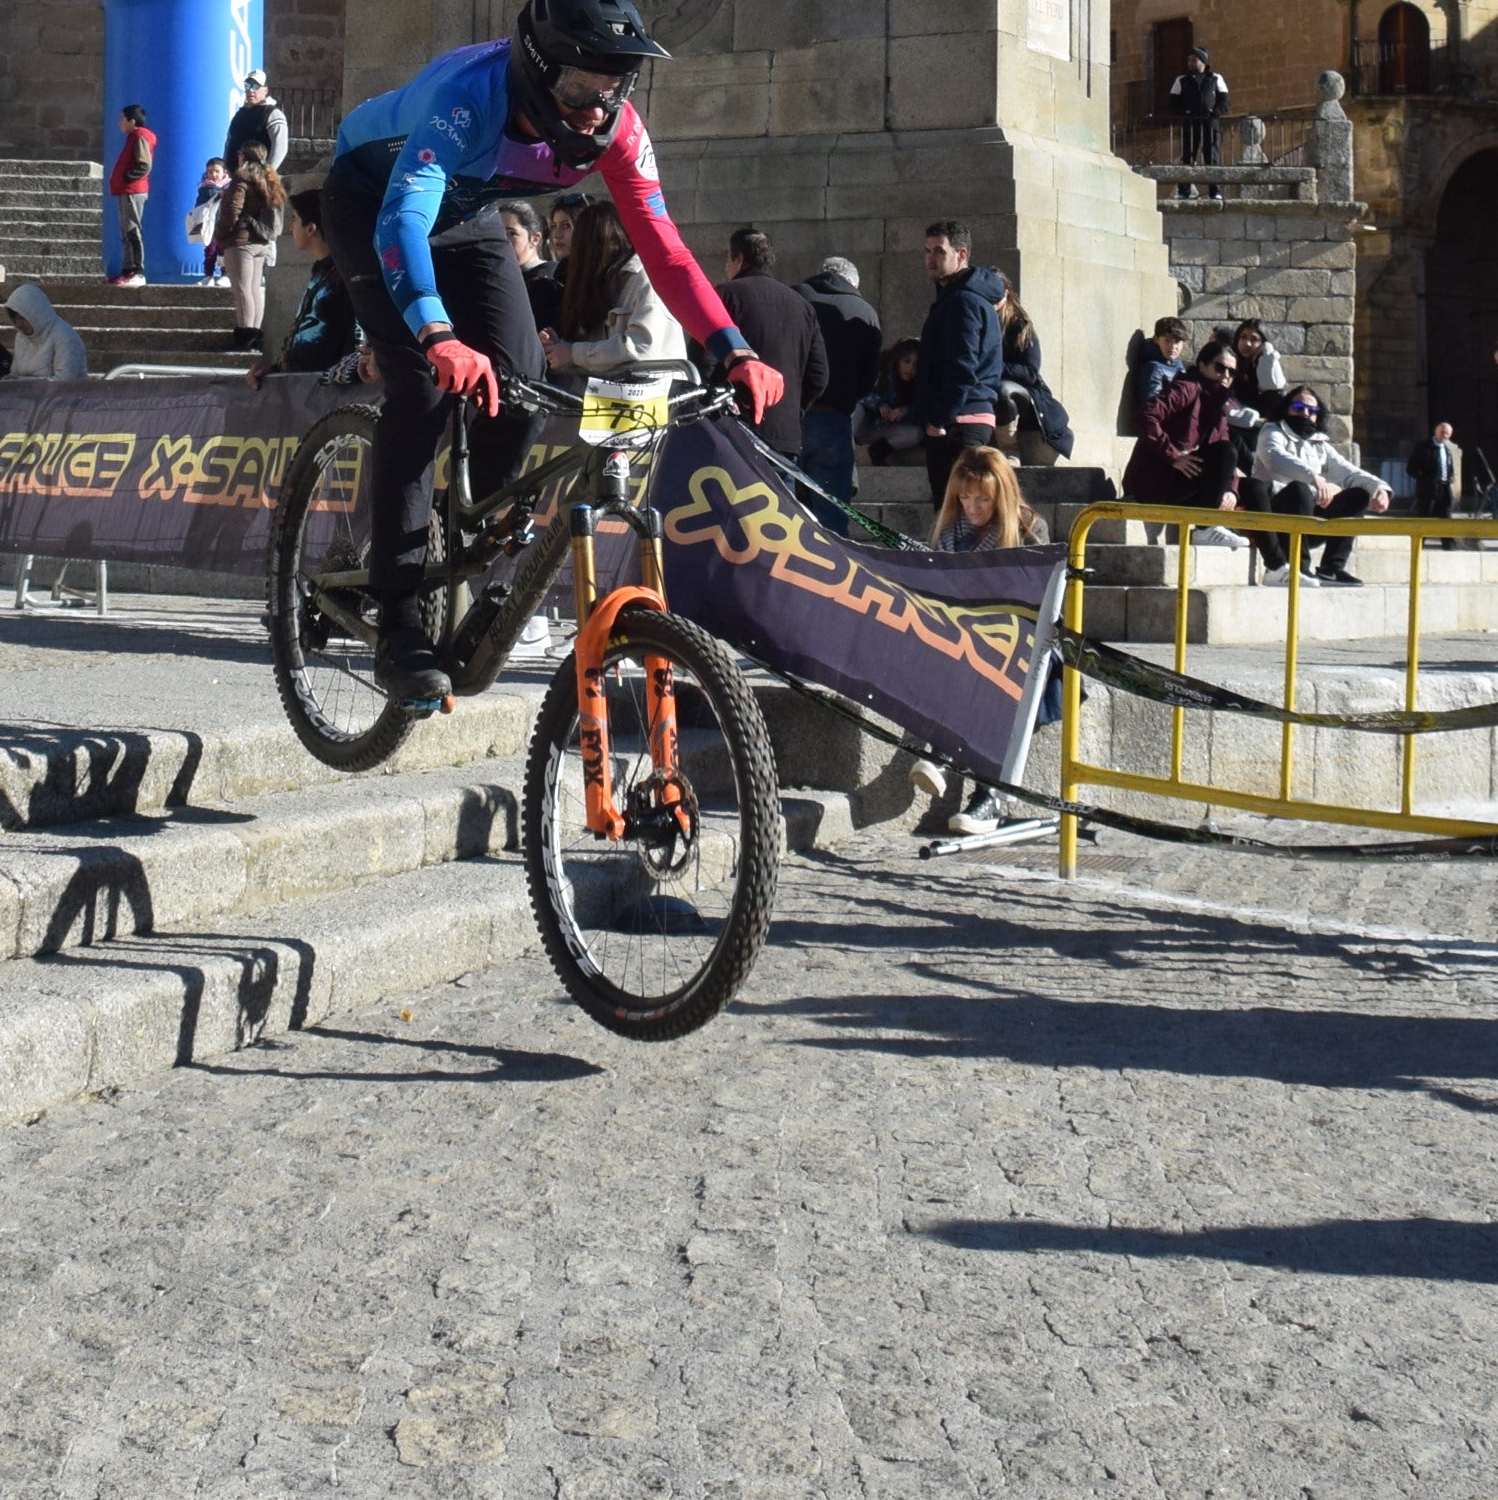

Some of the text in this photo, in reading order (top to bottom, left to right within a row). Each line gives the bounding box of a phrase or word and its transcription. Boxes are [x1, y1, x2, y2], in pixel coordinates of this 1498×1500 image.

[523, 34, 549, 73] SMITH
[517, 513, 564, 598] MOUNTAIN
[581, 727, 605, 789] FOX
